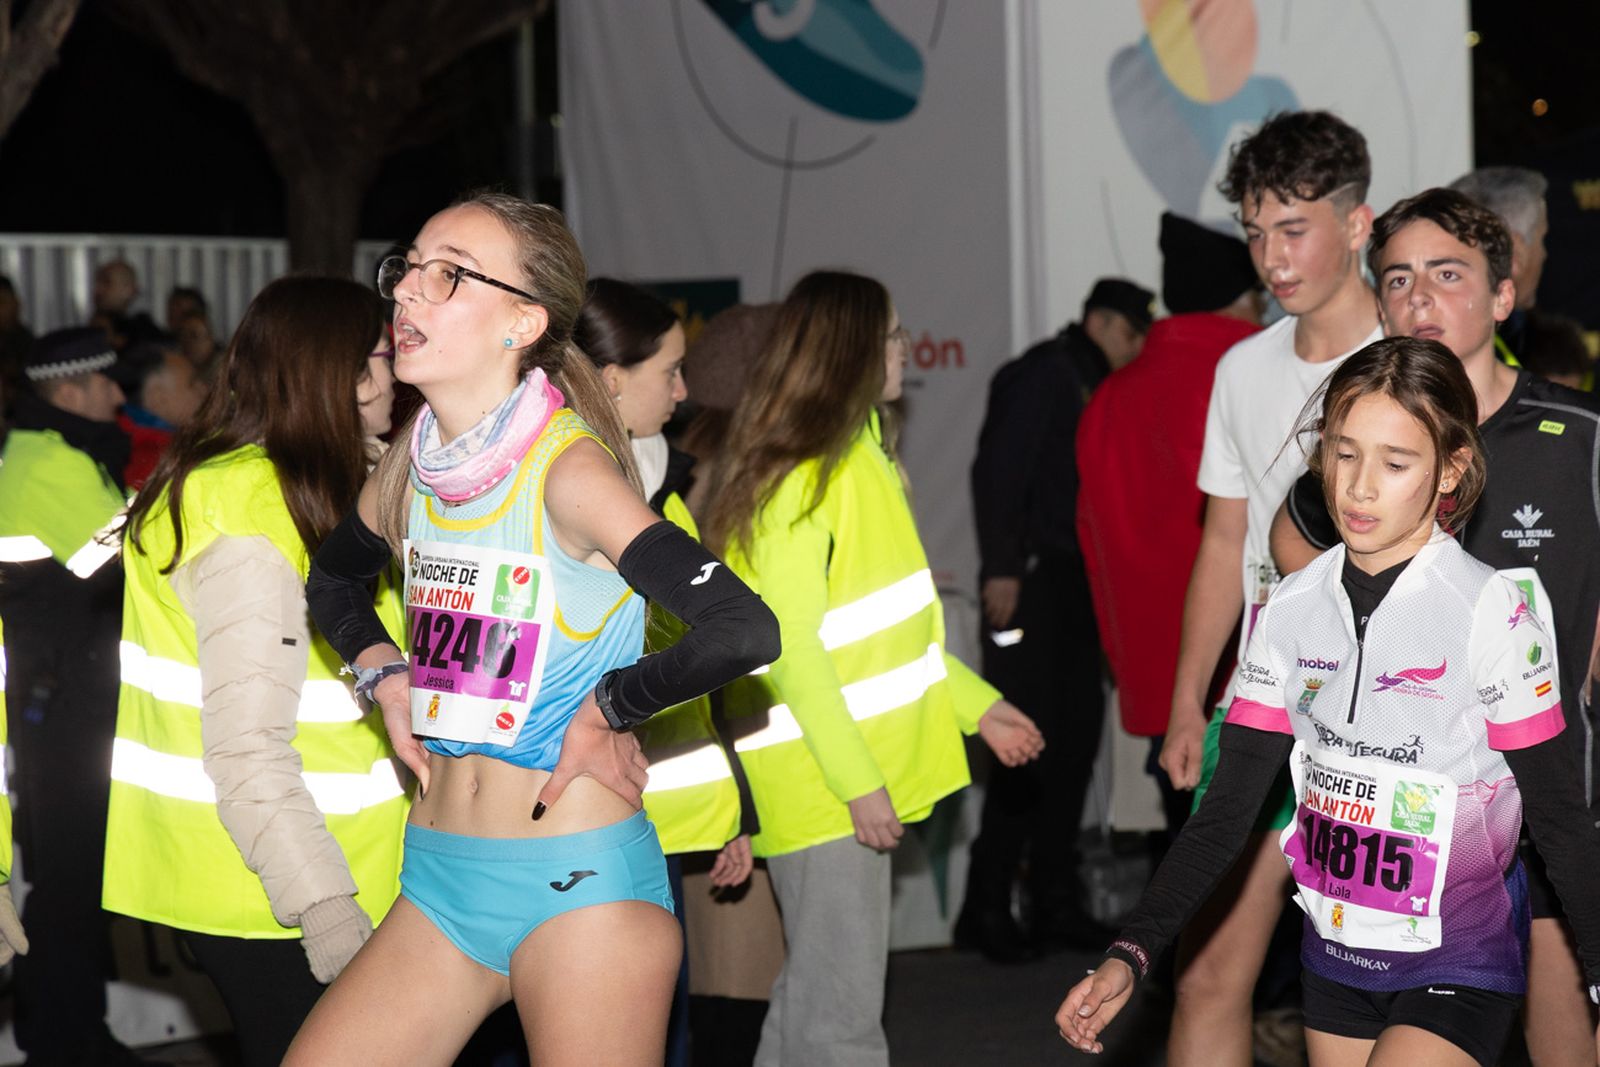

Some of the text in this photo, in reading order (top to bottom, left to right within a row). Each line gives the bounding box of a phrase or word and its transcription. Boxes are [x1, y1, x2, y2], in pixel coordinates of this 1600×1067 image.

[419, 562, 457, 583] NOCHE
[458, 567, 479, 586] DE
[425, 585, 475, 611] ANTÓN
[423, 673, 455, 690] Jessica
[1312, 768, 1377, 801] NOCHE DE
[1321, 798, 1375, 825] ANTÓN
[1303, 813, 1414, 893] 14815
[1328, 882, 1351, 899] Lola
[1325, 943, 1391, 971] BUJARKAY
